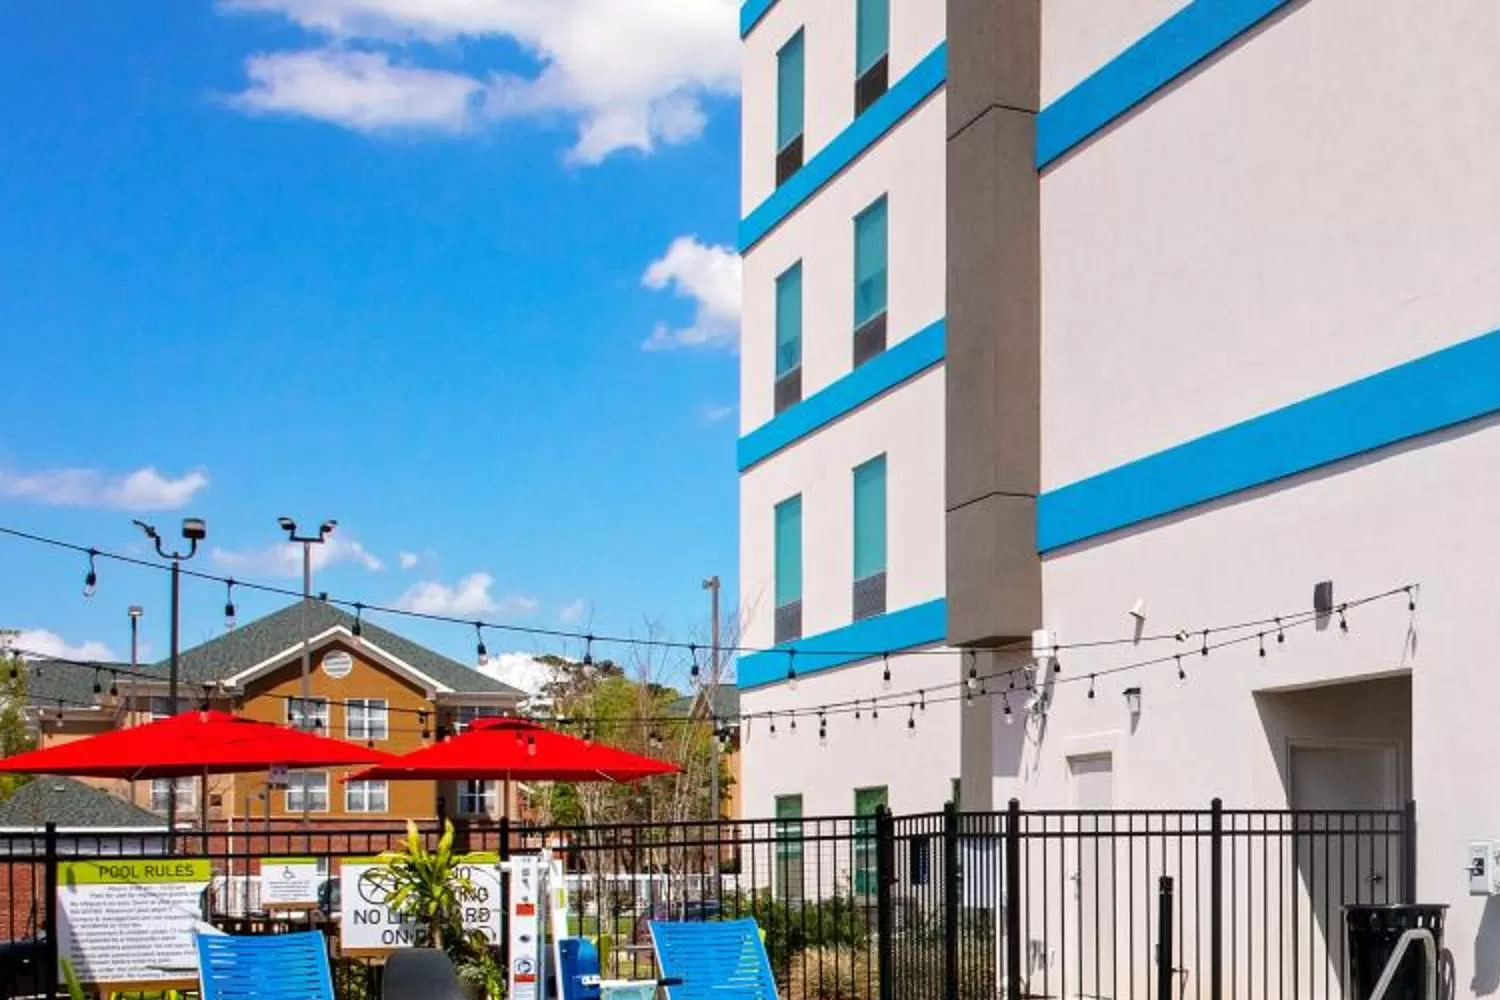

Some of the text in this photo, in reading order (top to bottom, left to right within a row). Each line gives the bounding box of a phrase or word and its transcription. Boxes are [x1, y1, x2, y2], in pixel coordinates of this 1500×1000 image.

[99, 864, 193, 879] POOL RULES
[353, 909, 381, 925] NO
[381, 929, 409, 945] ON
